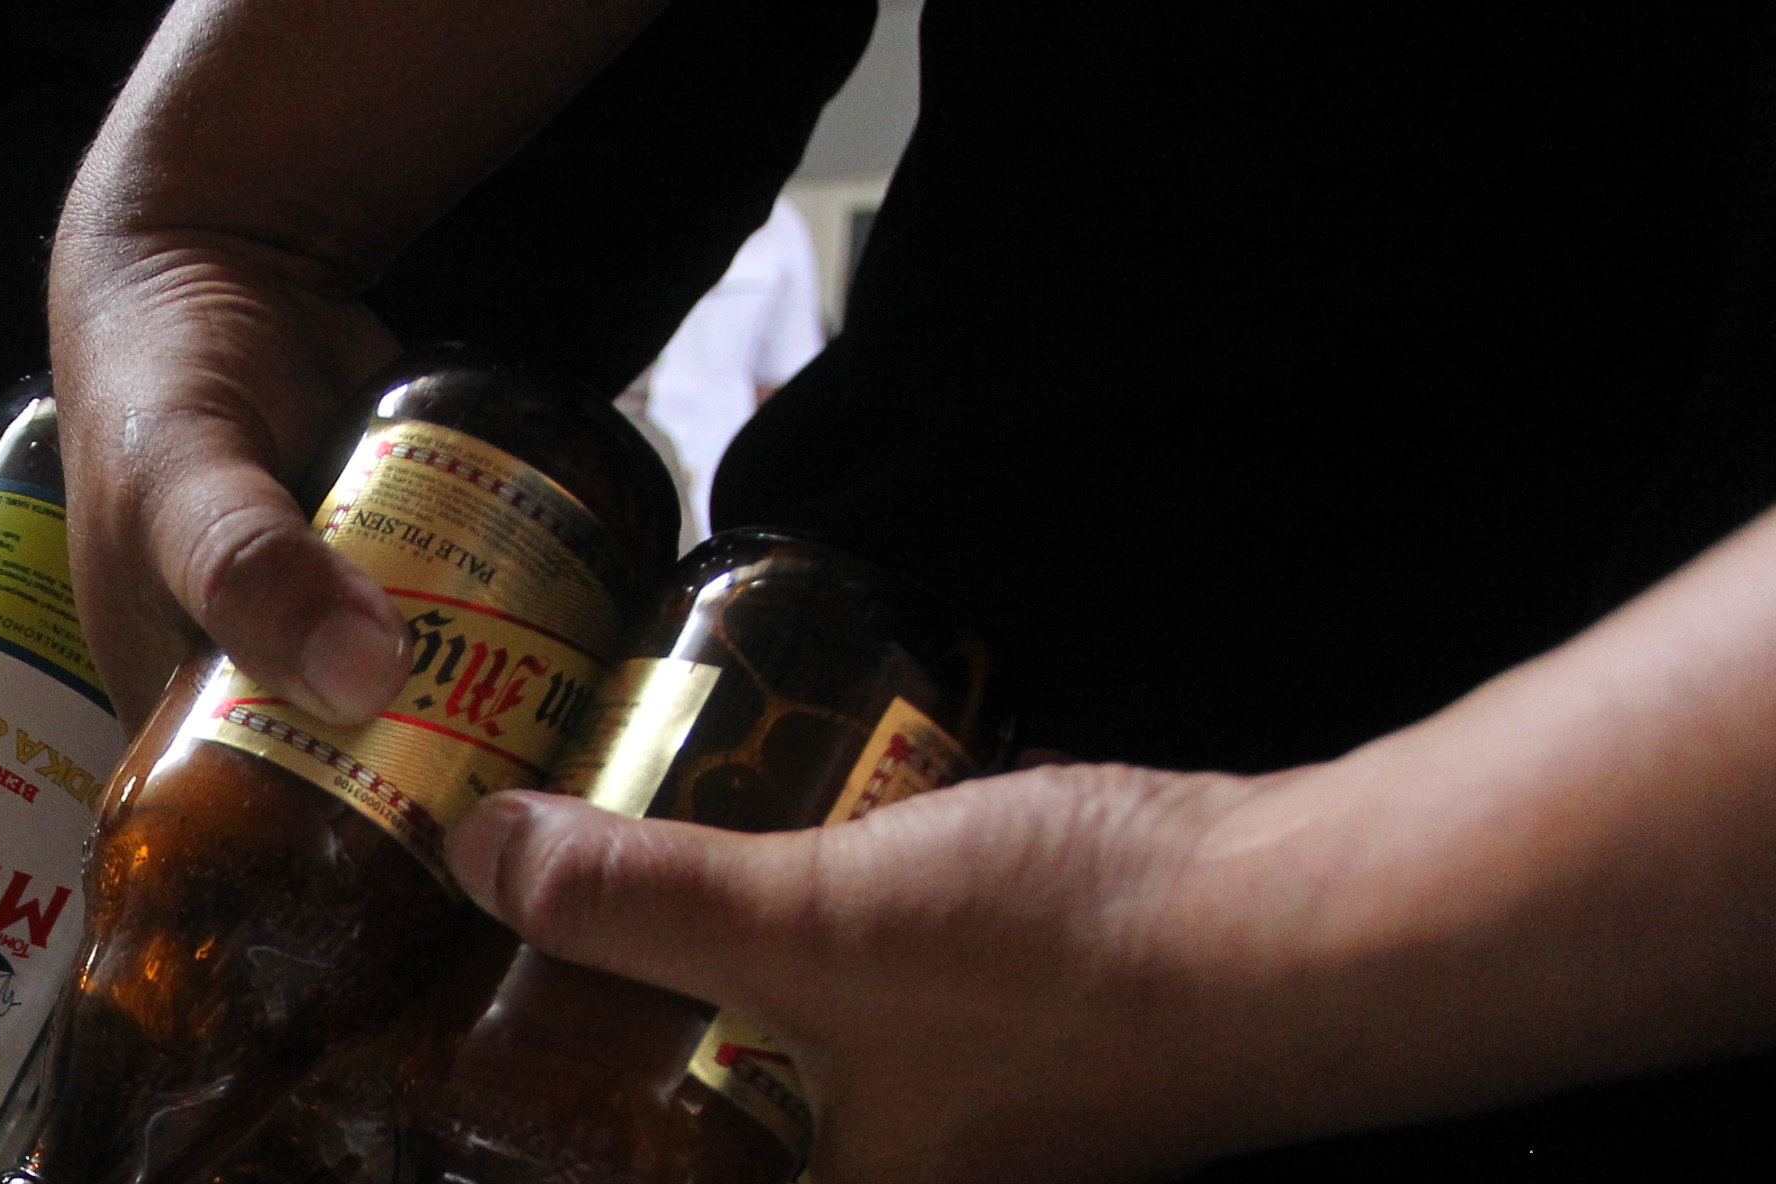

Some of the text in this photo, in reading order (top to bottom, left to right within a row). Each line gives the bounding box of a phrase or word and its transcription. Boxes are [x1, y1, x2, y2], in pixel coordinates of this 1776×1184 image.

[351, 508, 497, 585] PALE PILSEN
[407, 610, 552, 737] Mig
[16, 727, 105, 812] ODKA
